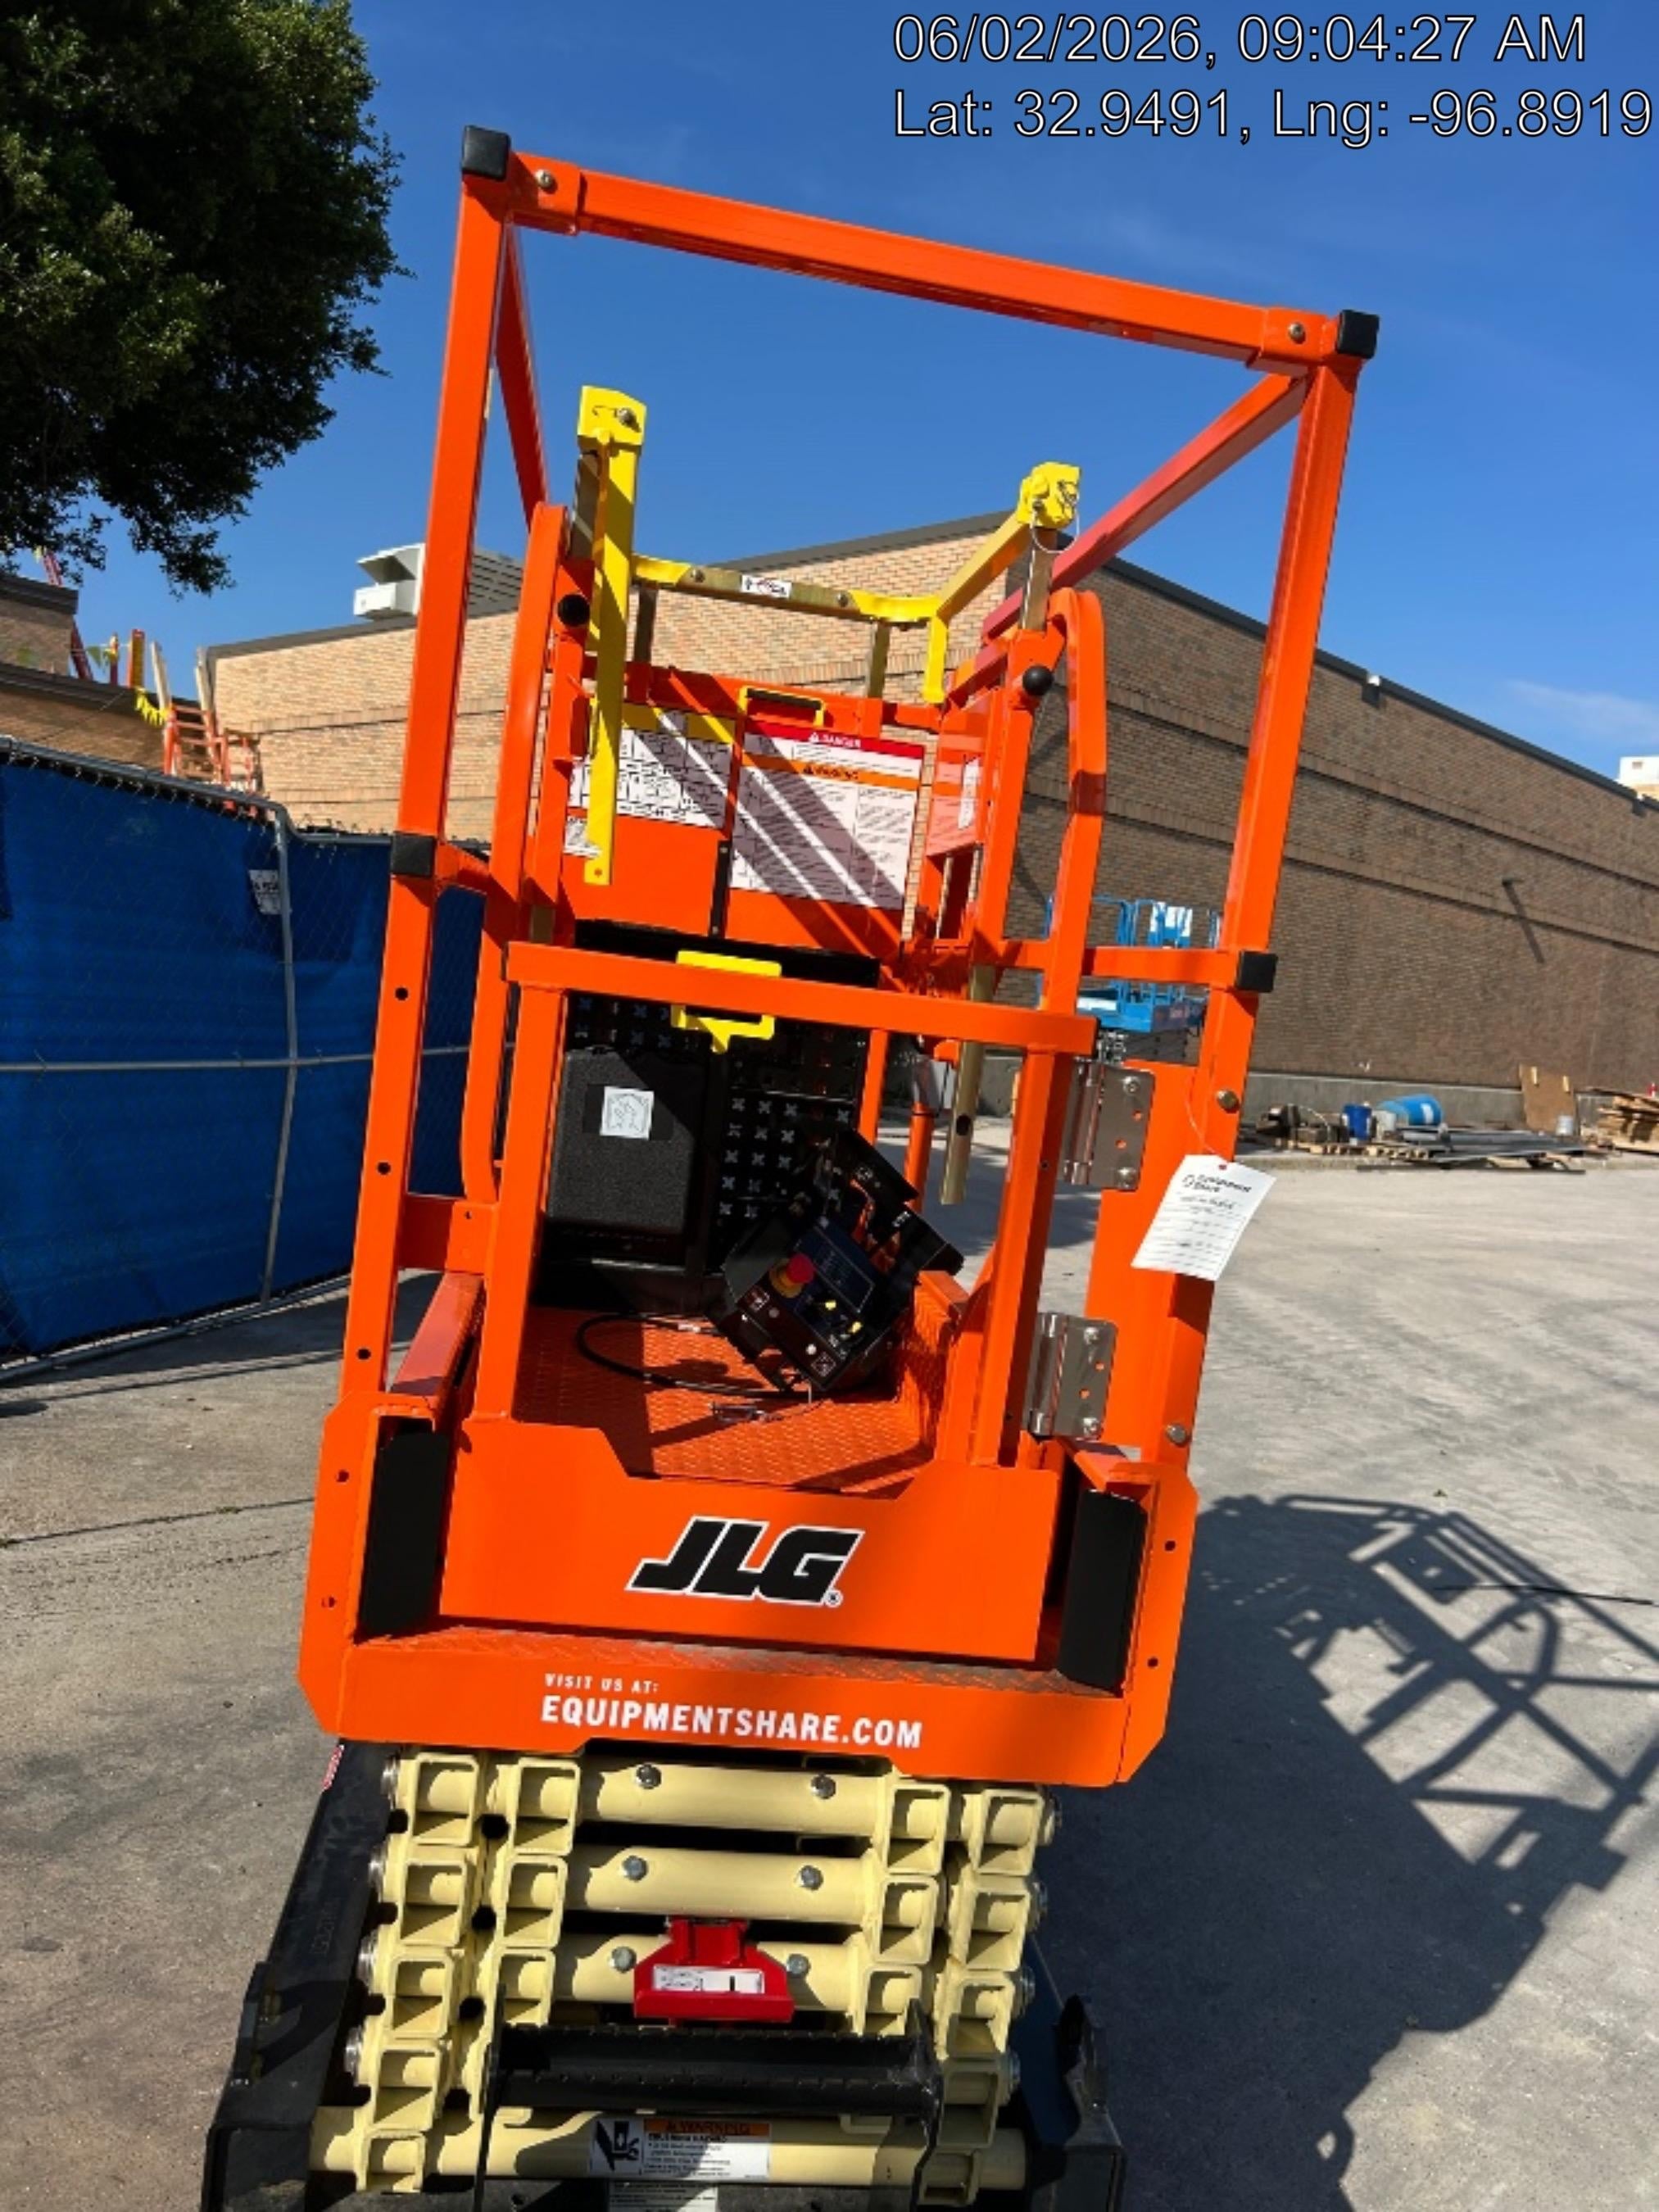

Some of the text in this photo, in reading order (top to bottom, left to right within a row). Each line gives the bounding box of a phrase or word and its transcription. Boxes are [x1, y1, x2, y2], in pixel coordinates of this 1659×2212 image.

[625, 1516, 865, 1606] JLG
[544, 1672, 659, 1694] VISIT US AT:
[541, 1694, 922, 1748] EQUIPMENTSHARE.COM
